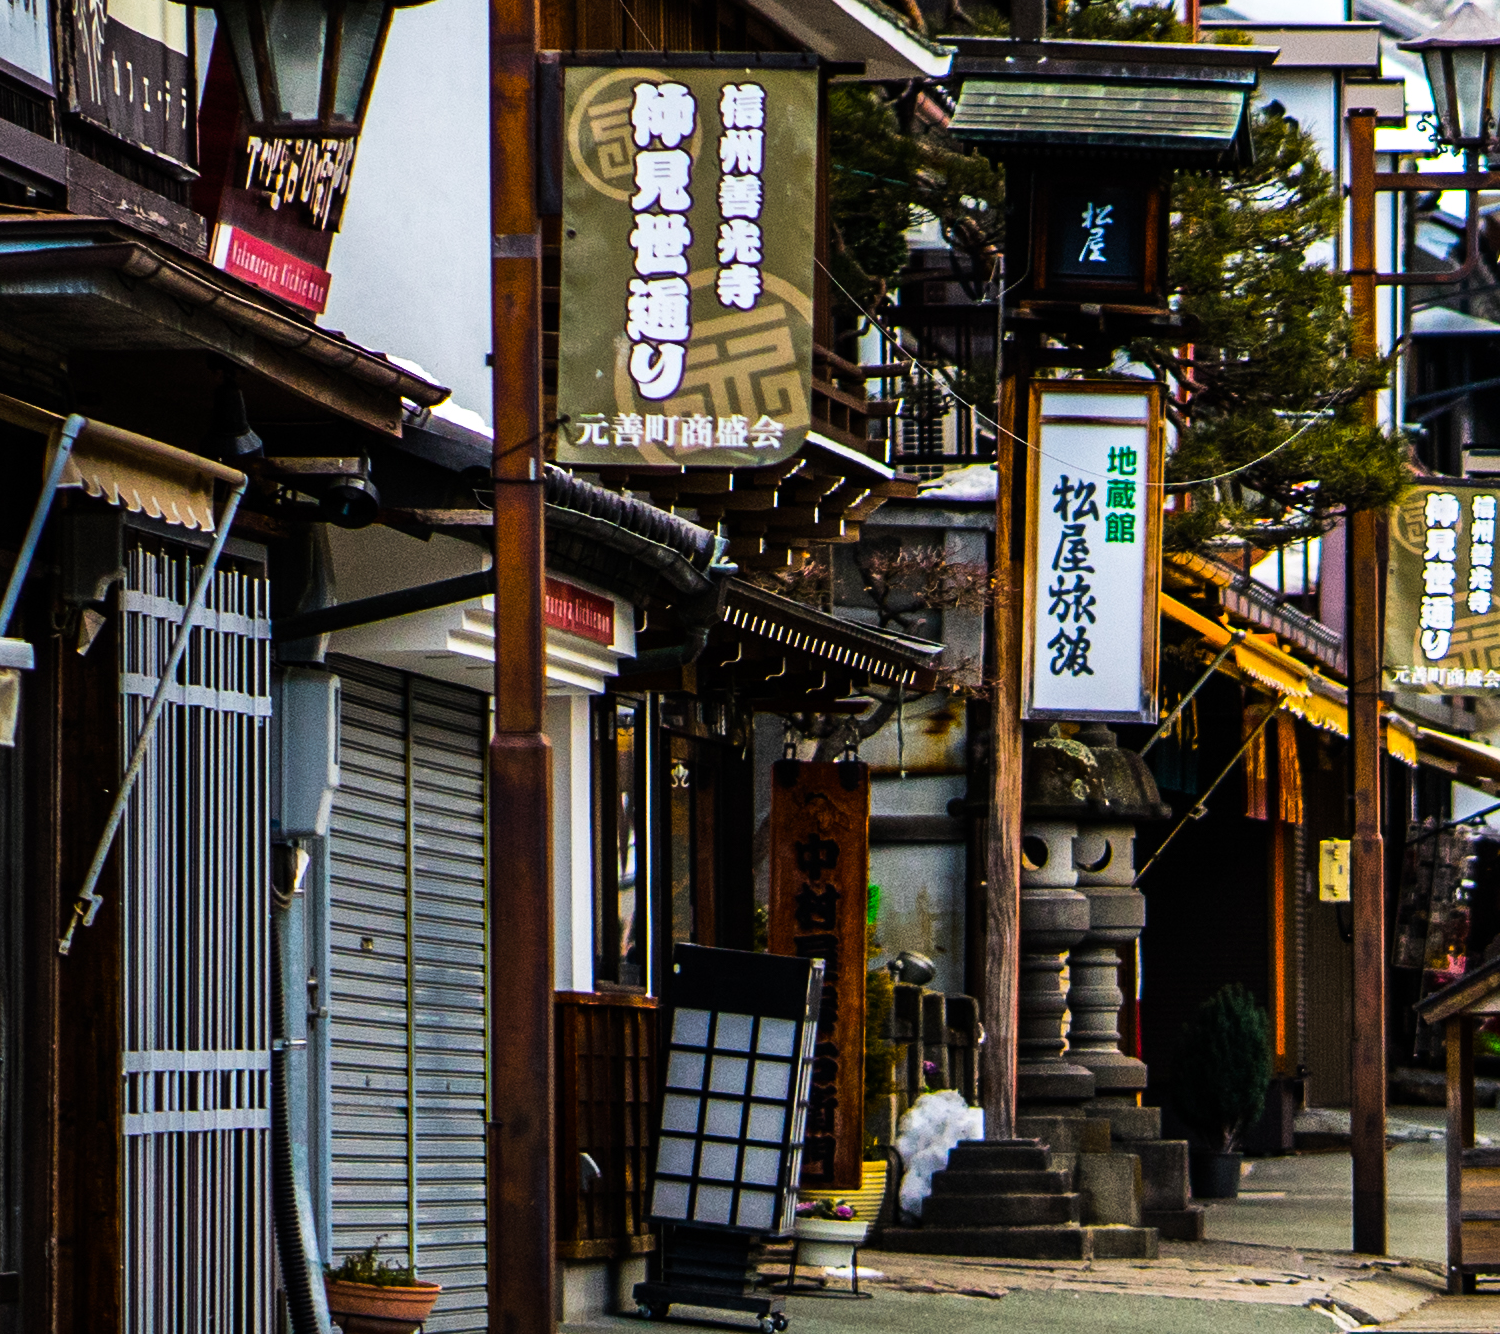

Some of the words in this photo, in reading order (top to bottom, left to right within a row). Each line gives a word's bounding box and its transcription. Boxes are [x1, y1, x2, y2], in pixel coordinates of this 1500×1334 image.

[628, 82, 697, 400] 仲見世通り
[716, 82, 766, 311] 信州善光寺
[574, 412, 785, 449] 元善町商盛会
[1104, 446, 1137, 544] 地蔵館
[1046, 474, 1100, 677] 松屋旅館
